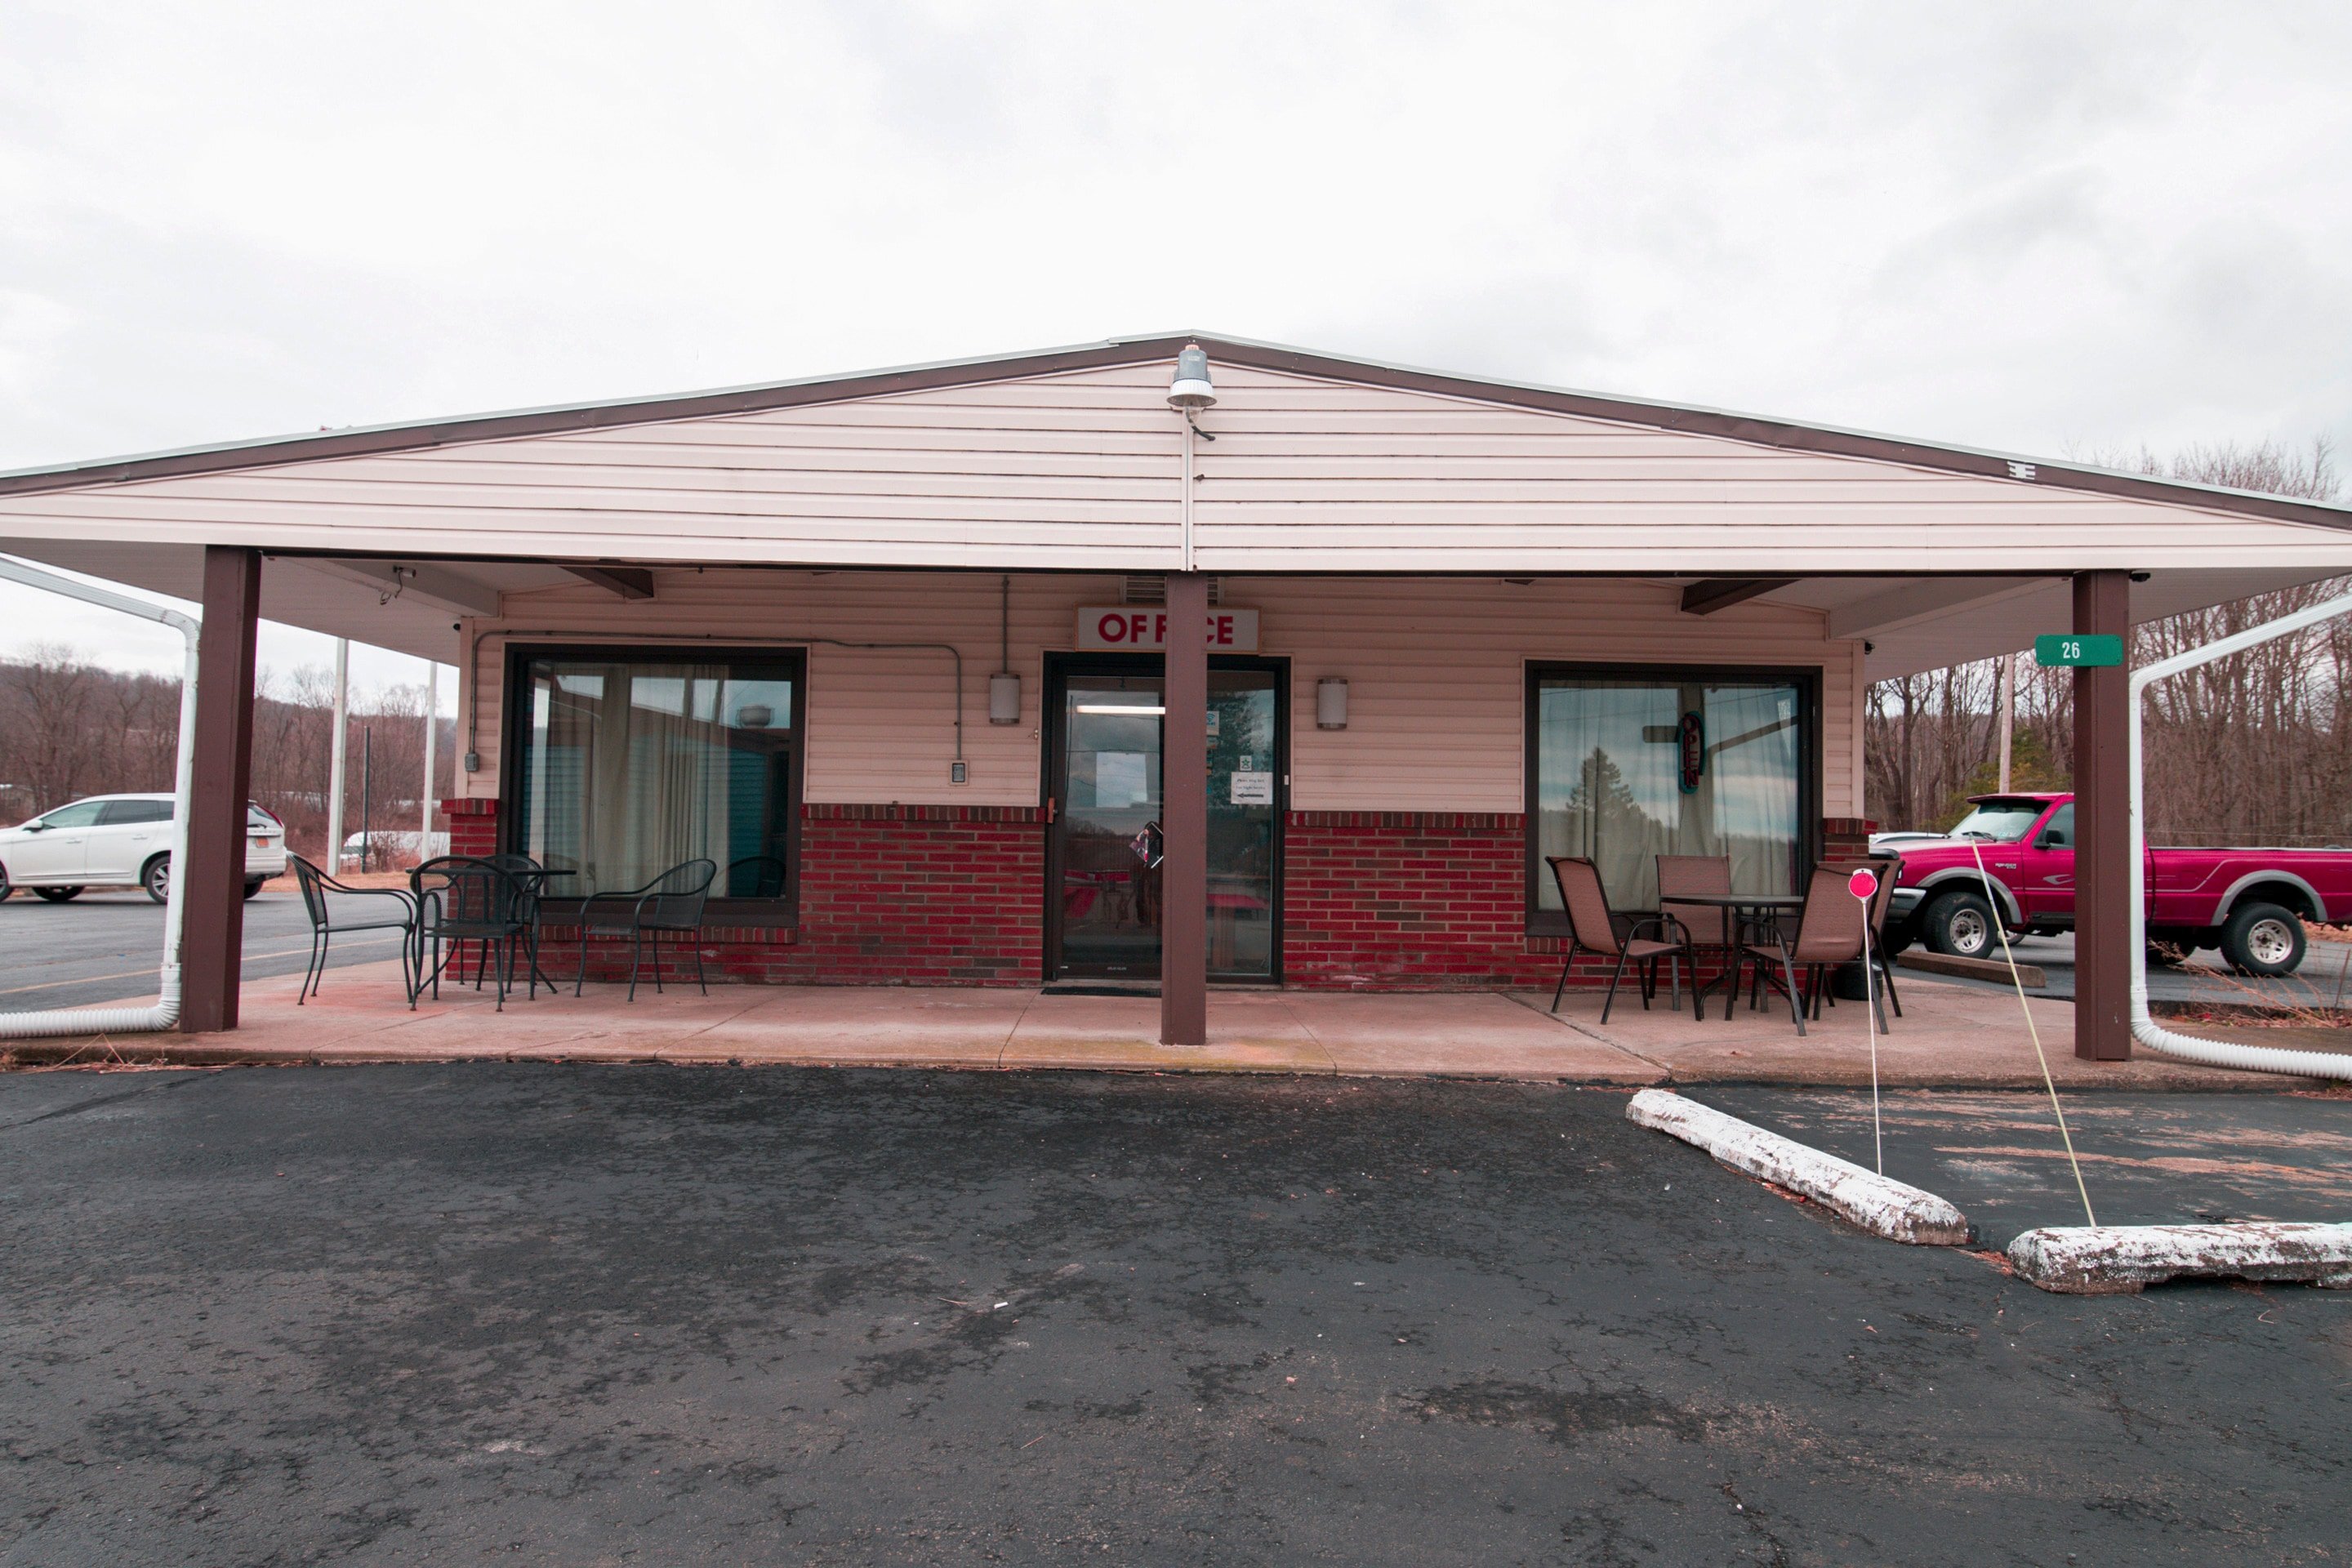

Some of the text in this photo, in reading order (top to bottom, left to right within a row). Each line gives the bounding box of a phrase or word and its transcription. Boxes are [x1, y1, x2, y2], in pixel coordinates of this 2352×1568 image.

[1098, 613, 1233, 644] OFFE
[2061, 642, 2081, 659] 26
[1683, 715, 1699, 786] OPEN
